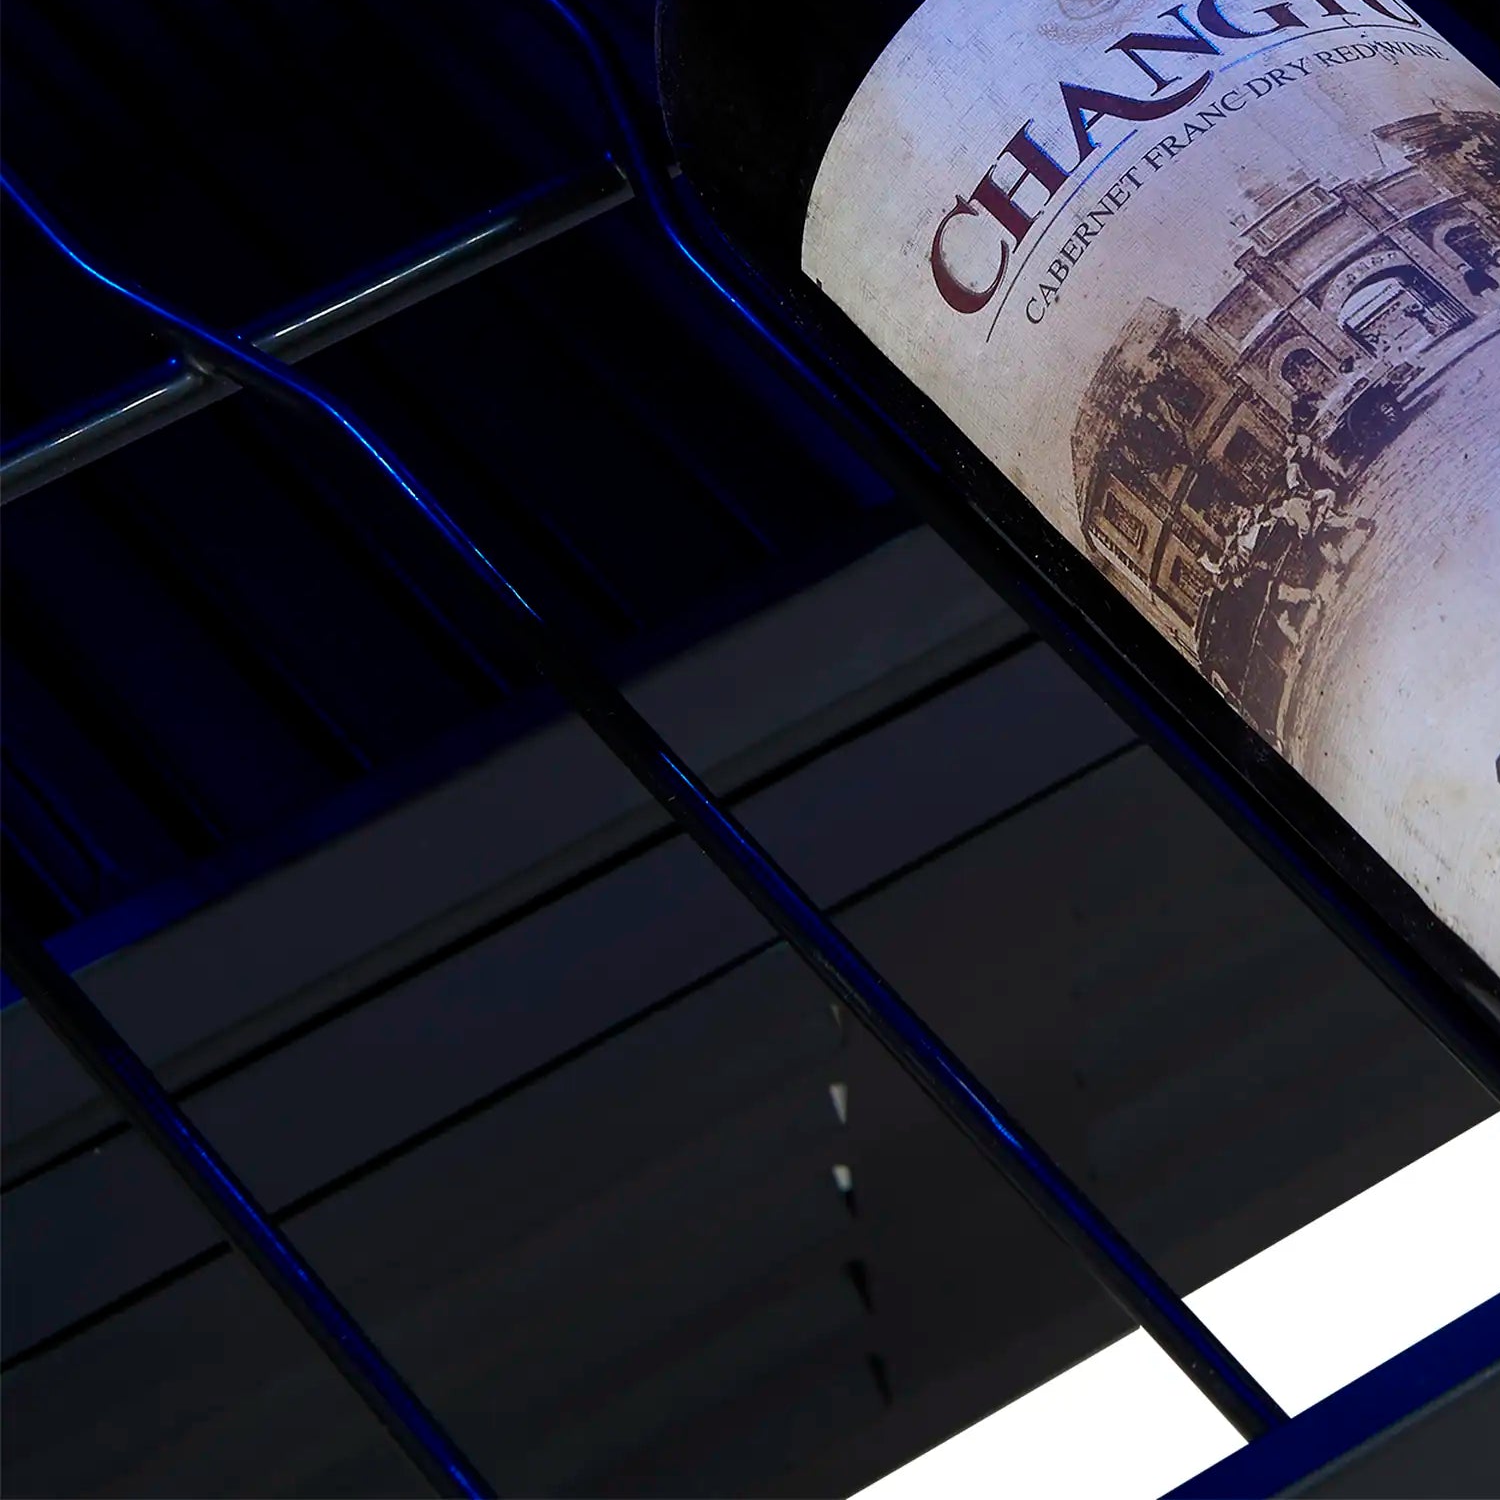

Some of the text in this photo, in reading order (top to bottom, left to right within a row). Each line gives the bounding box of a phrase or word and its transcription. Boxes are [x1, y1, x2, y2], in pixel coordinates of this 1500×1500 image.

[1025, 41, 1450, 324] CABERNET FRANC DRY RED WINE
